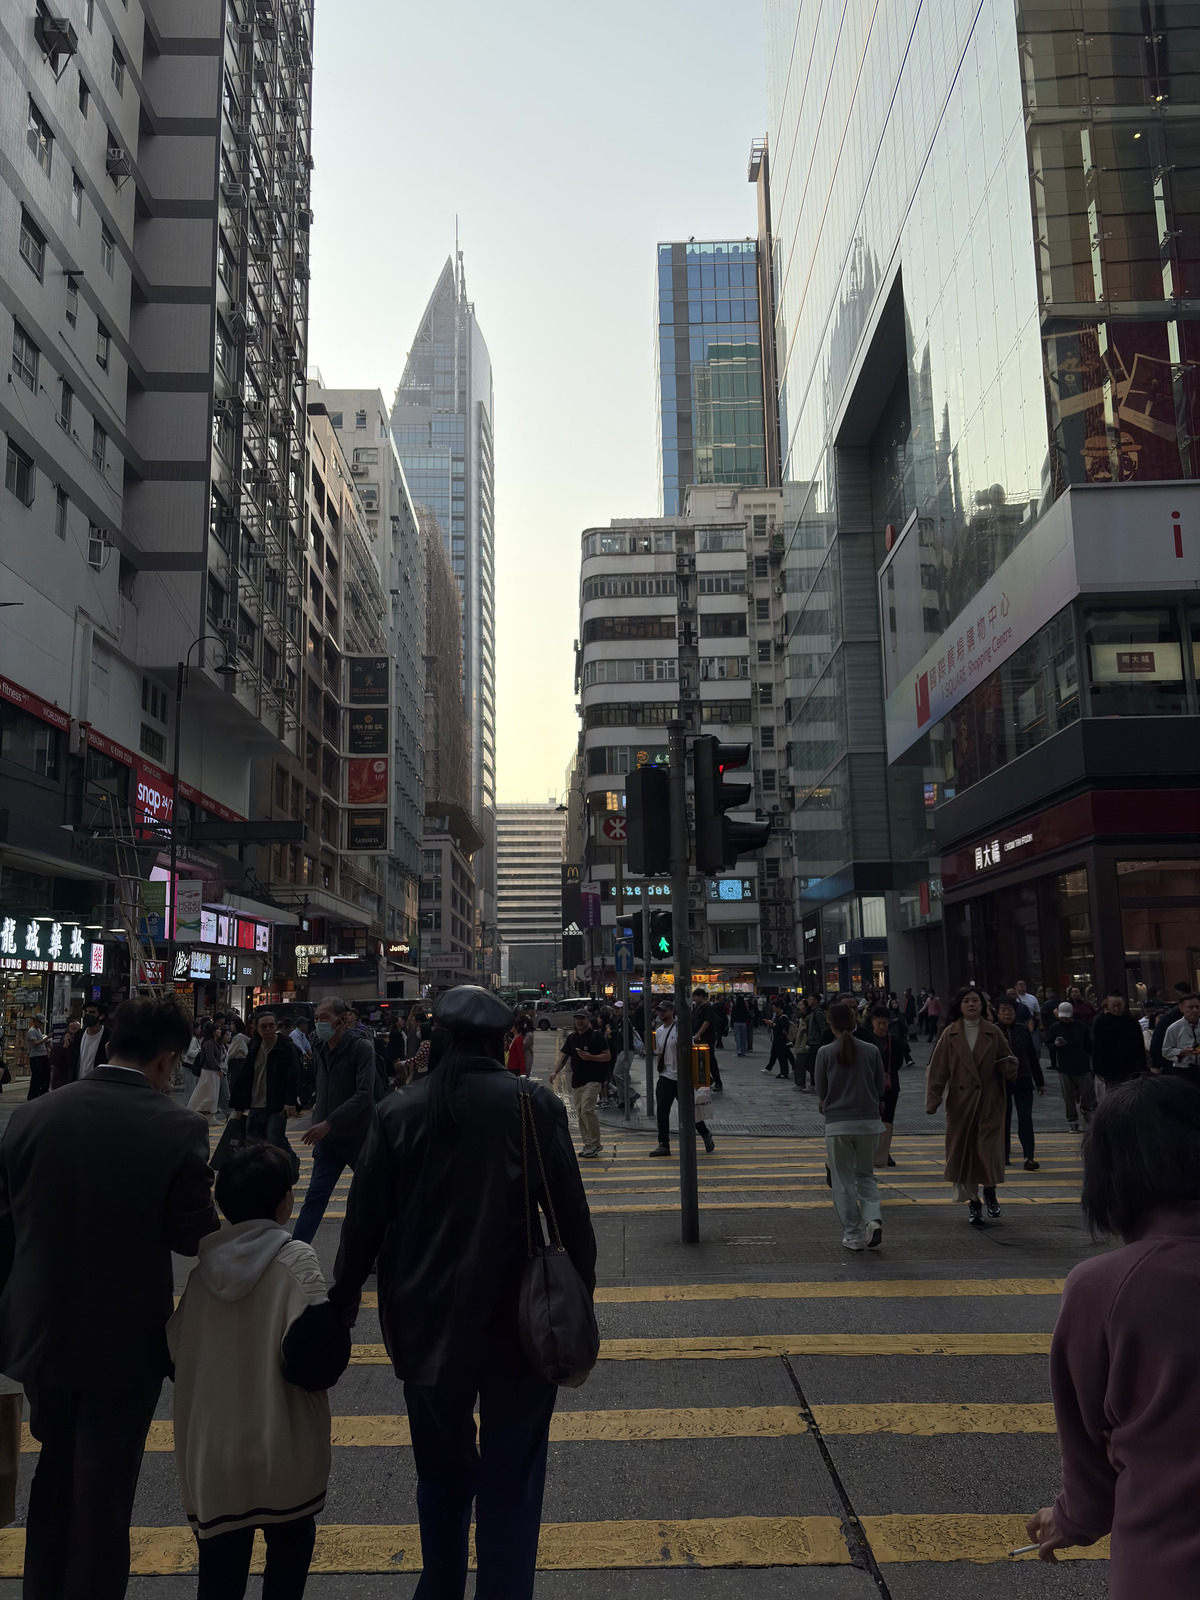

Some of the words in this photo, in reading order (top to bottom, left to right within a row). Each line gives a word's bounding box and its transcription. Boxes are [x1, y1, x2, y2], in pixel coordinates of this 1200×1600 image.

[968, 646, 991, 676] Shopping
[991, 627, 1013, 652] Centre
[1121, 654, 1150, 664] 周大福
[2, 682, 22, 702] fitness
[42, 706, 68, 728] WORLDWIDE
[138, 782, 161, 814] snap
[161, 795, 174, 819] 24/7
[974, 839, 1001, 871] 周大福
[1, 958, 22, 970] LUNG
[25, 959, 49, 971] SHING
[52, 961, 84, 973] MEDICINE
